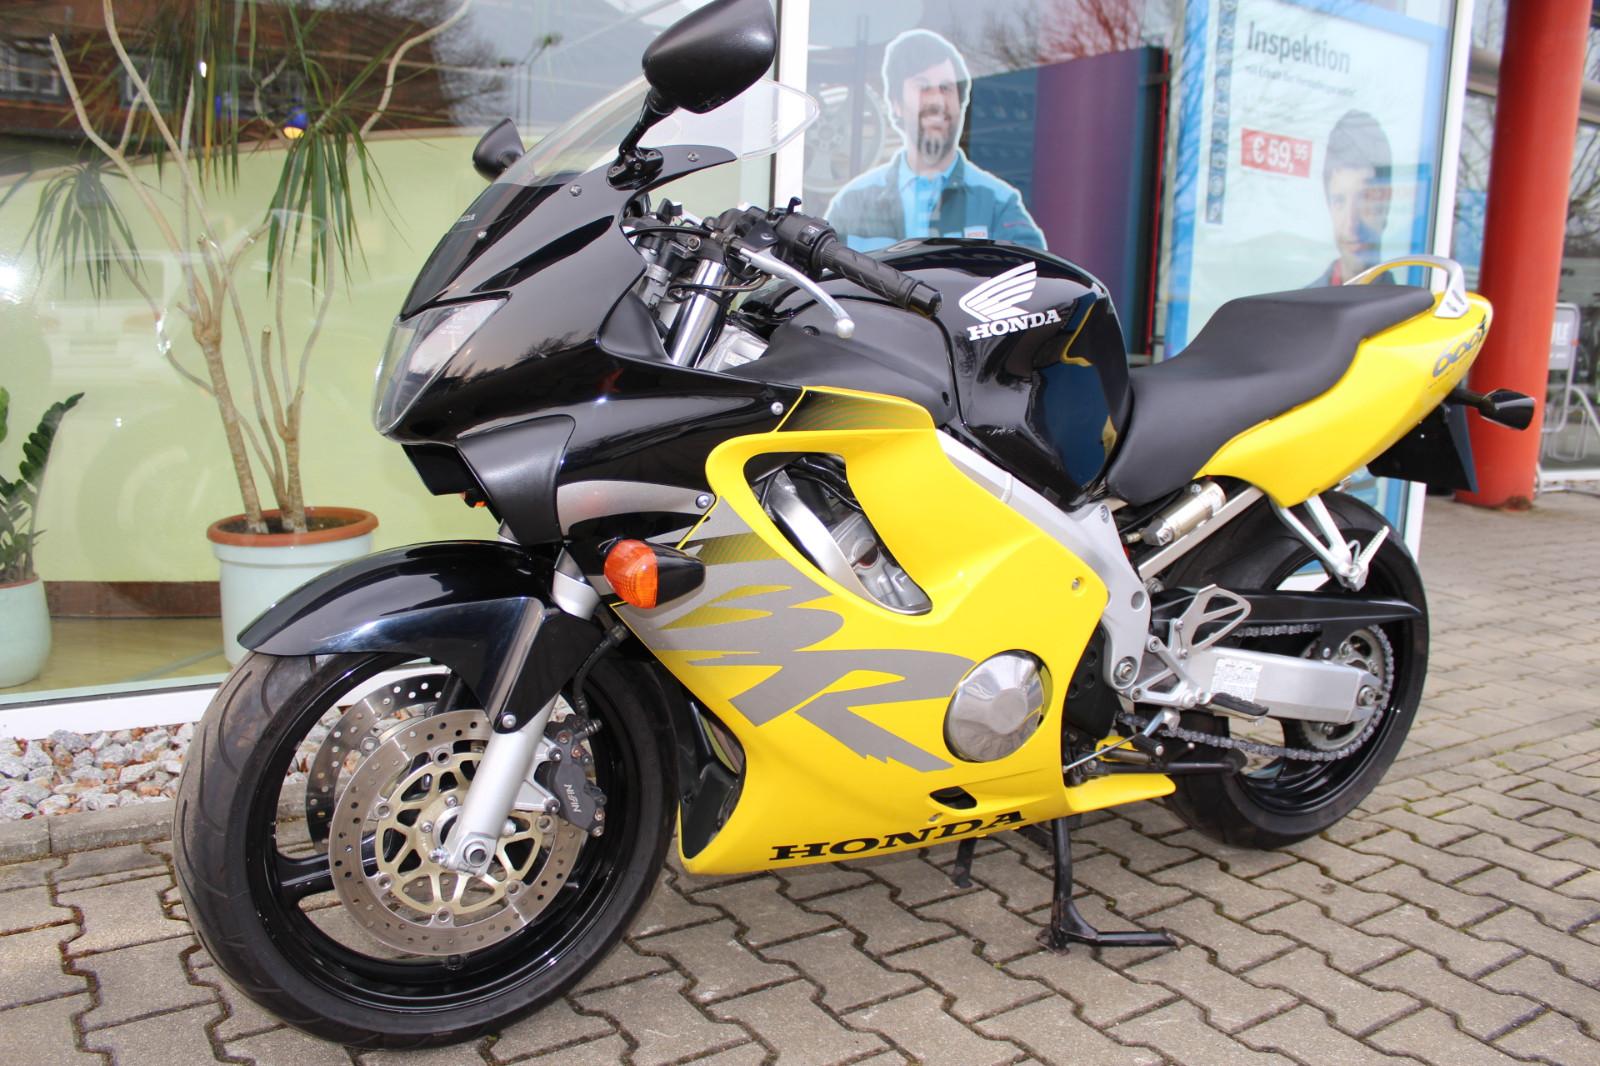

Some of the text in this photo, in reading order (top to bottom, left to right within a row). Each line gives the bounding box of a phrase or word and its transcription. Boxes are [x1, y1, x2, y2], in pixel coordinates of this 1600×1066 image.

[1247, 21, 1351, 74] Inspektion
[1252, 135, 1265, 163] €
[967, 309, 1061, 341] HONDA
[769, 810, 1026, 861] HONDA
